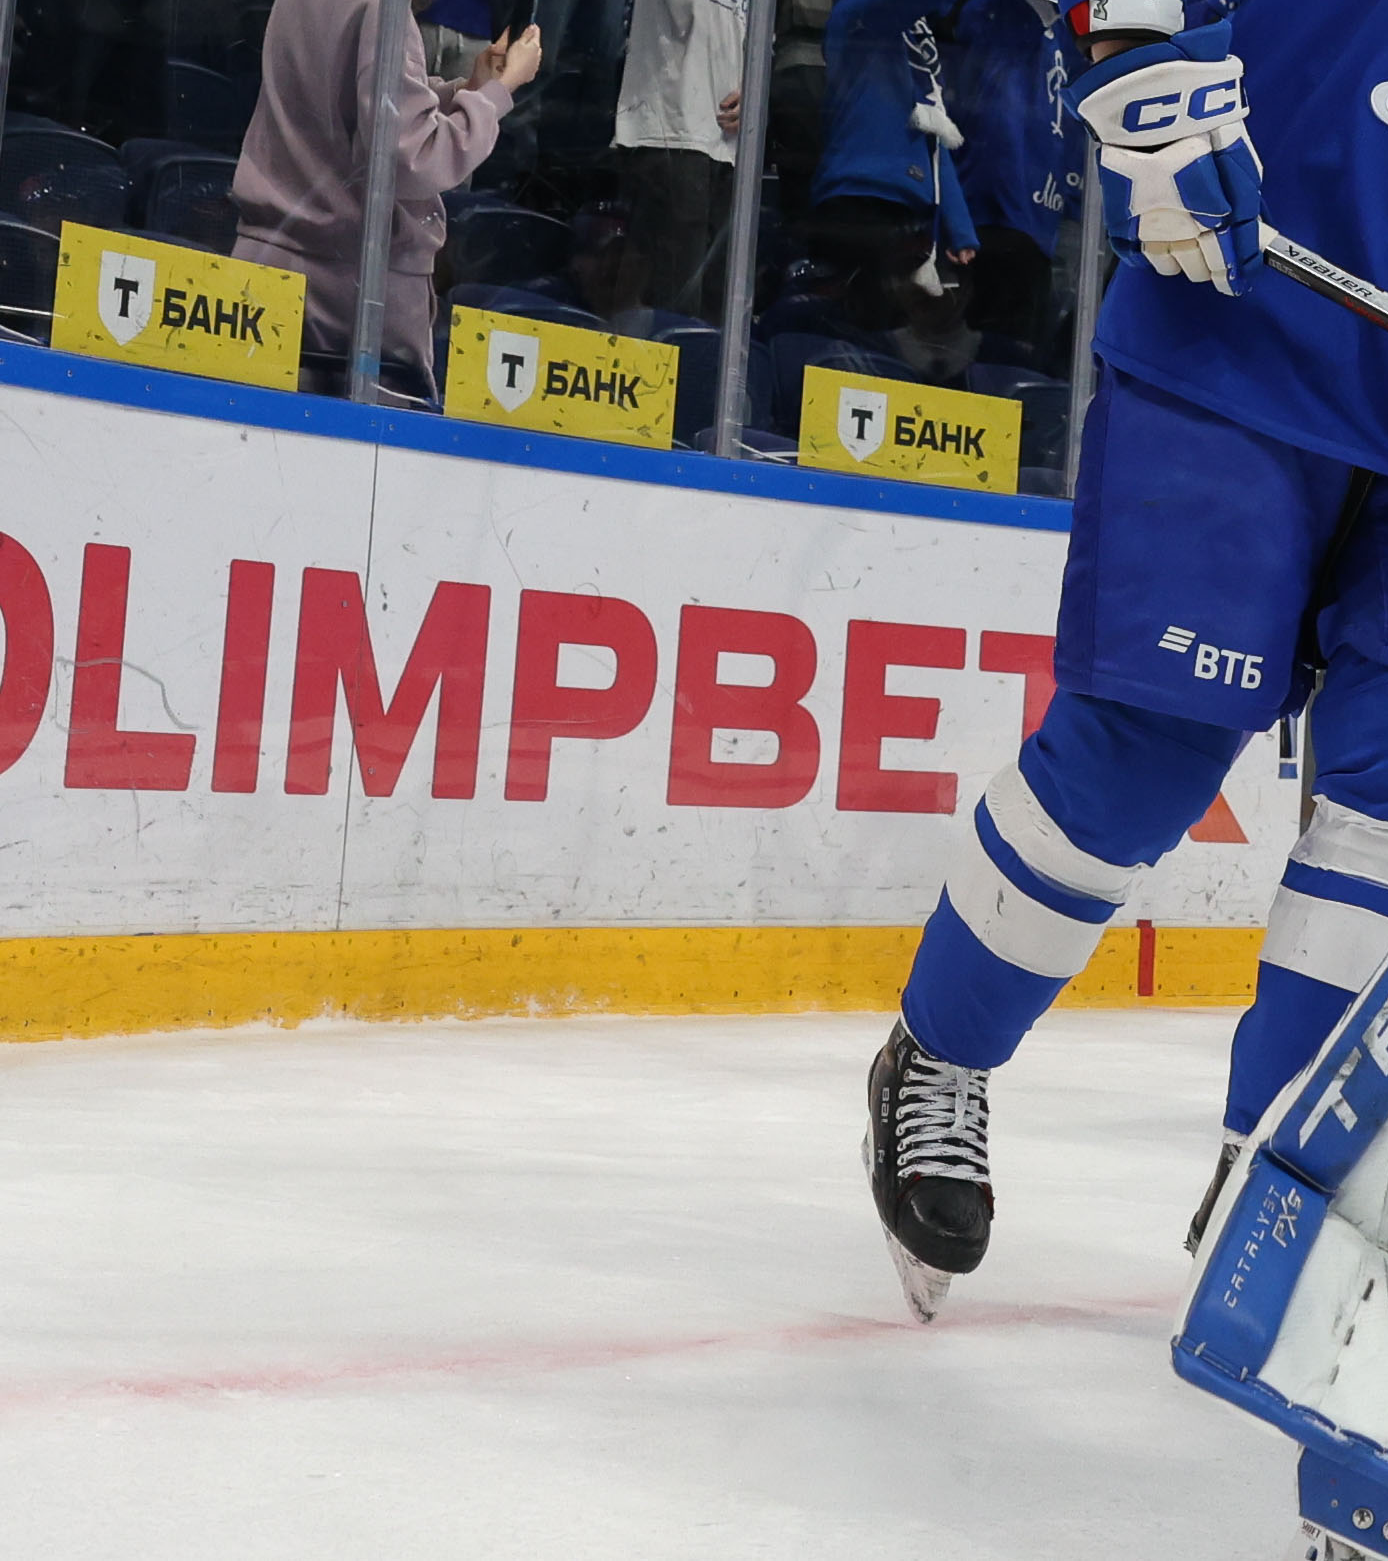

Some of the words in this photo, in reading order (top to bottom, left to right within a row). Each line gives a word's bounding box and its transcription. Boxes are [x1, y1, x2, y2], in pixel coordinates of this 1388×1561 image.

[1121, 78, 1249, 133] CC
[160, 288, 266, 346] БАНК
[545, 362, 642, 411] БАНК
[893, 415, 986, 459] БАНК
[1194, 643, 1265, 690] ВТБ
